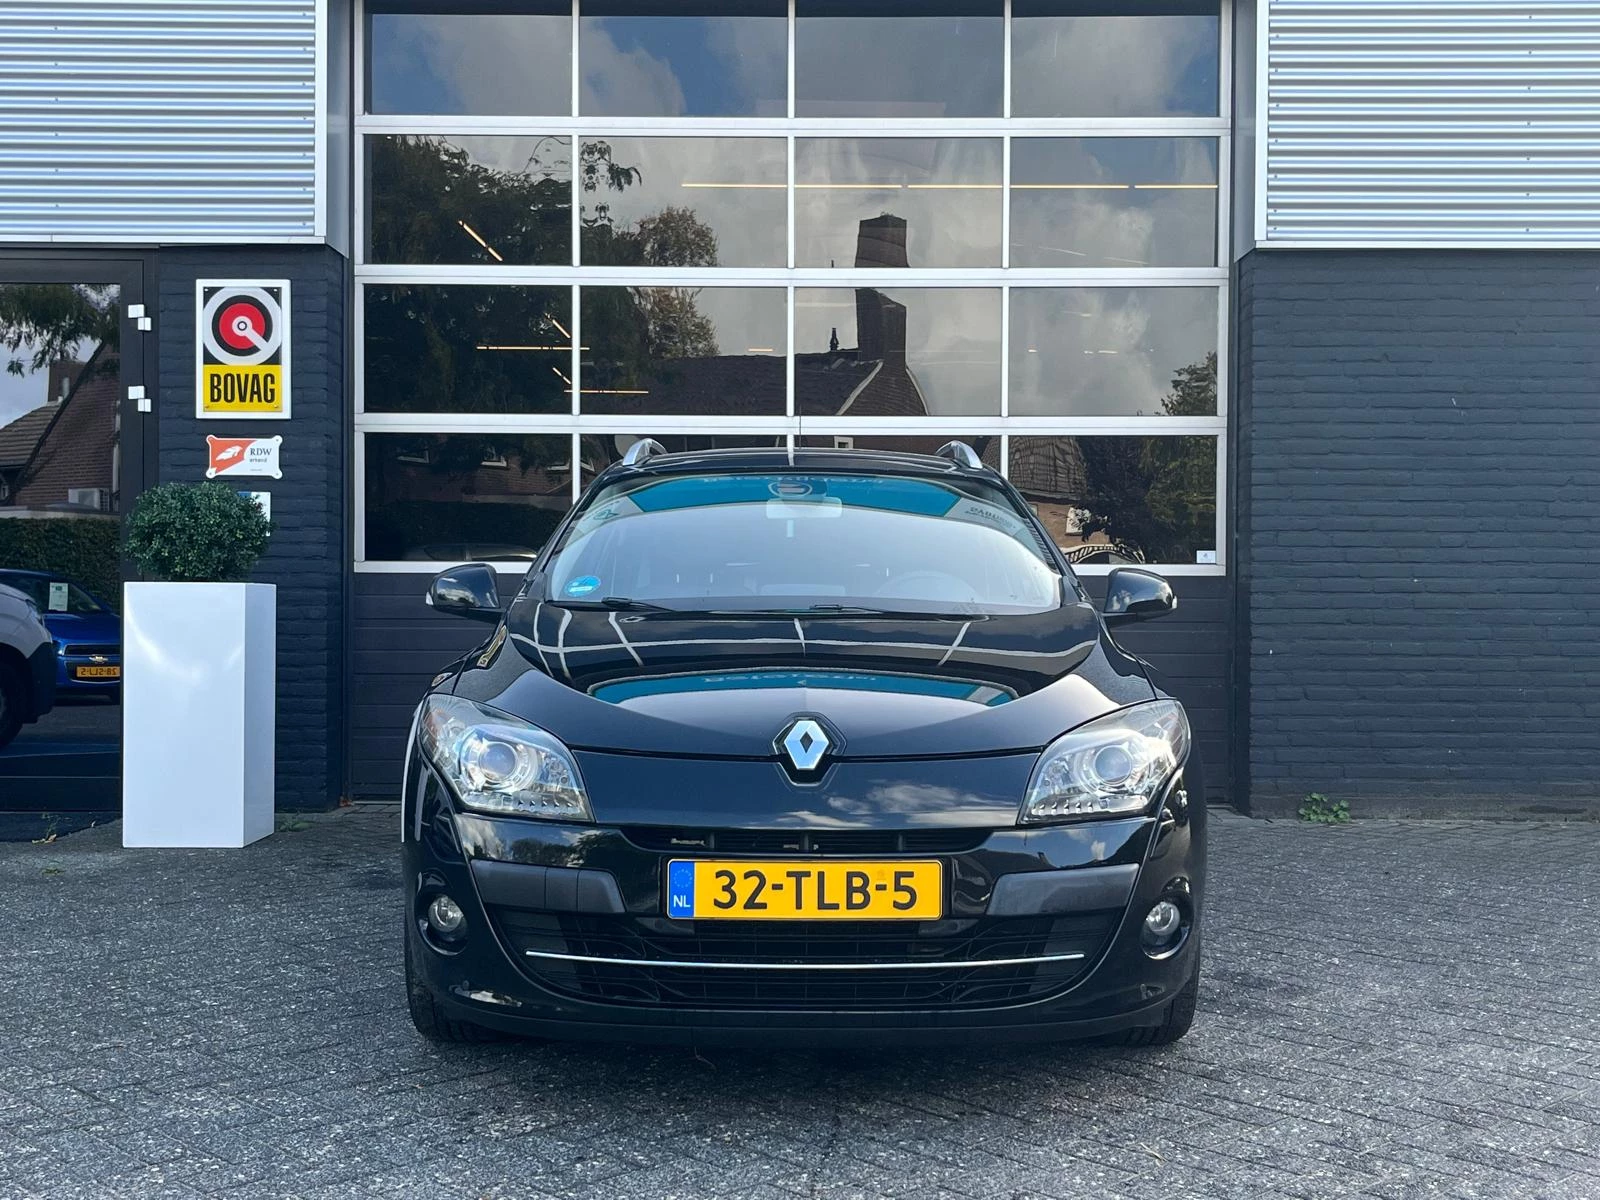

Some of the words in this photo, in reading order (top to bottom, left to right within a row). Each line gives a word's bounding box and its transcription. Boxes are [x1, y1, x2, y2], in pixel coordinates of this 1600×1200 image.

[210, 373, 275, 403] BOVAG
[250, 447, 272, 456] RDW
[673, 894, 691, 908] NL
[713, 869, 918, 911] 32-TLB-5
